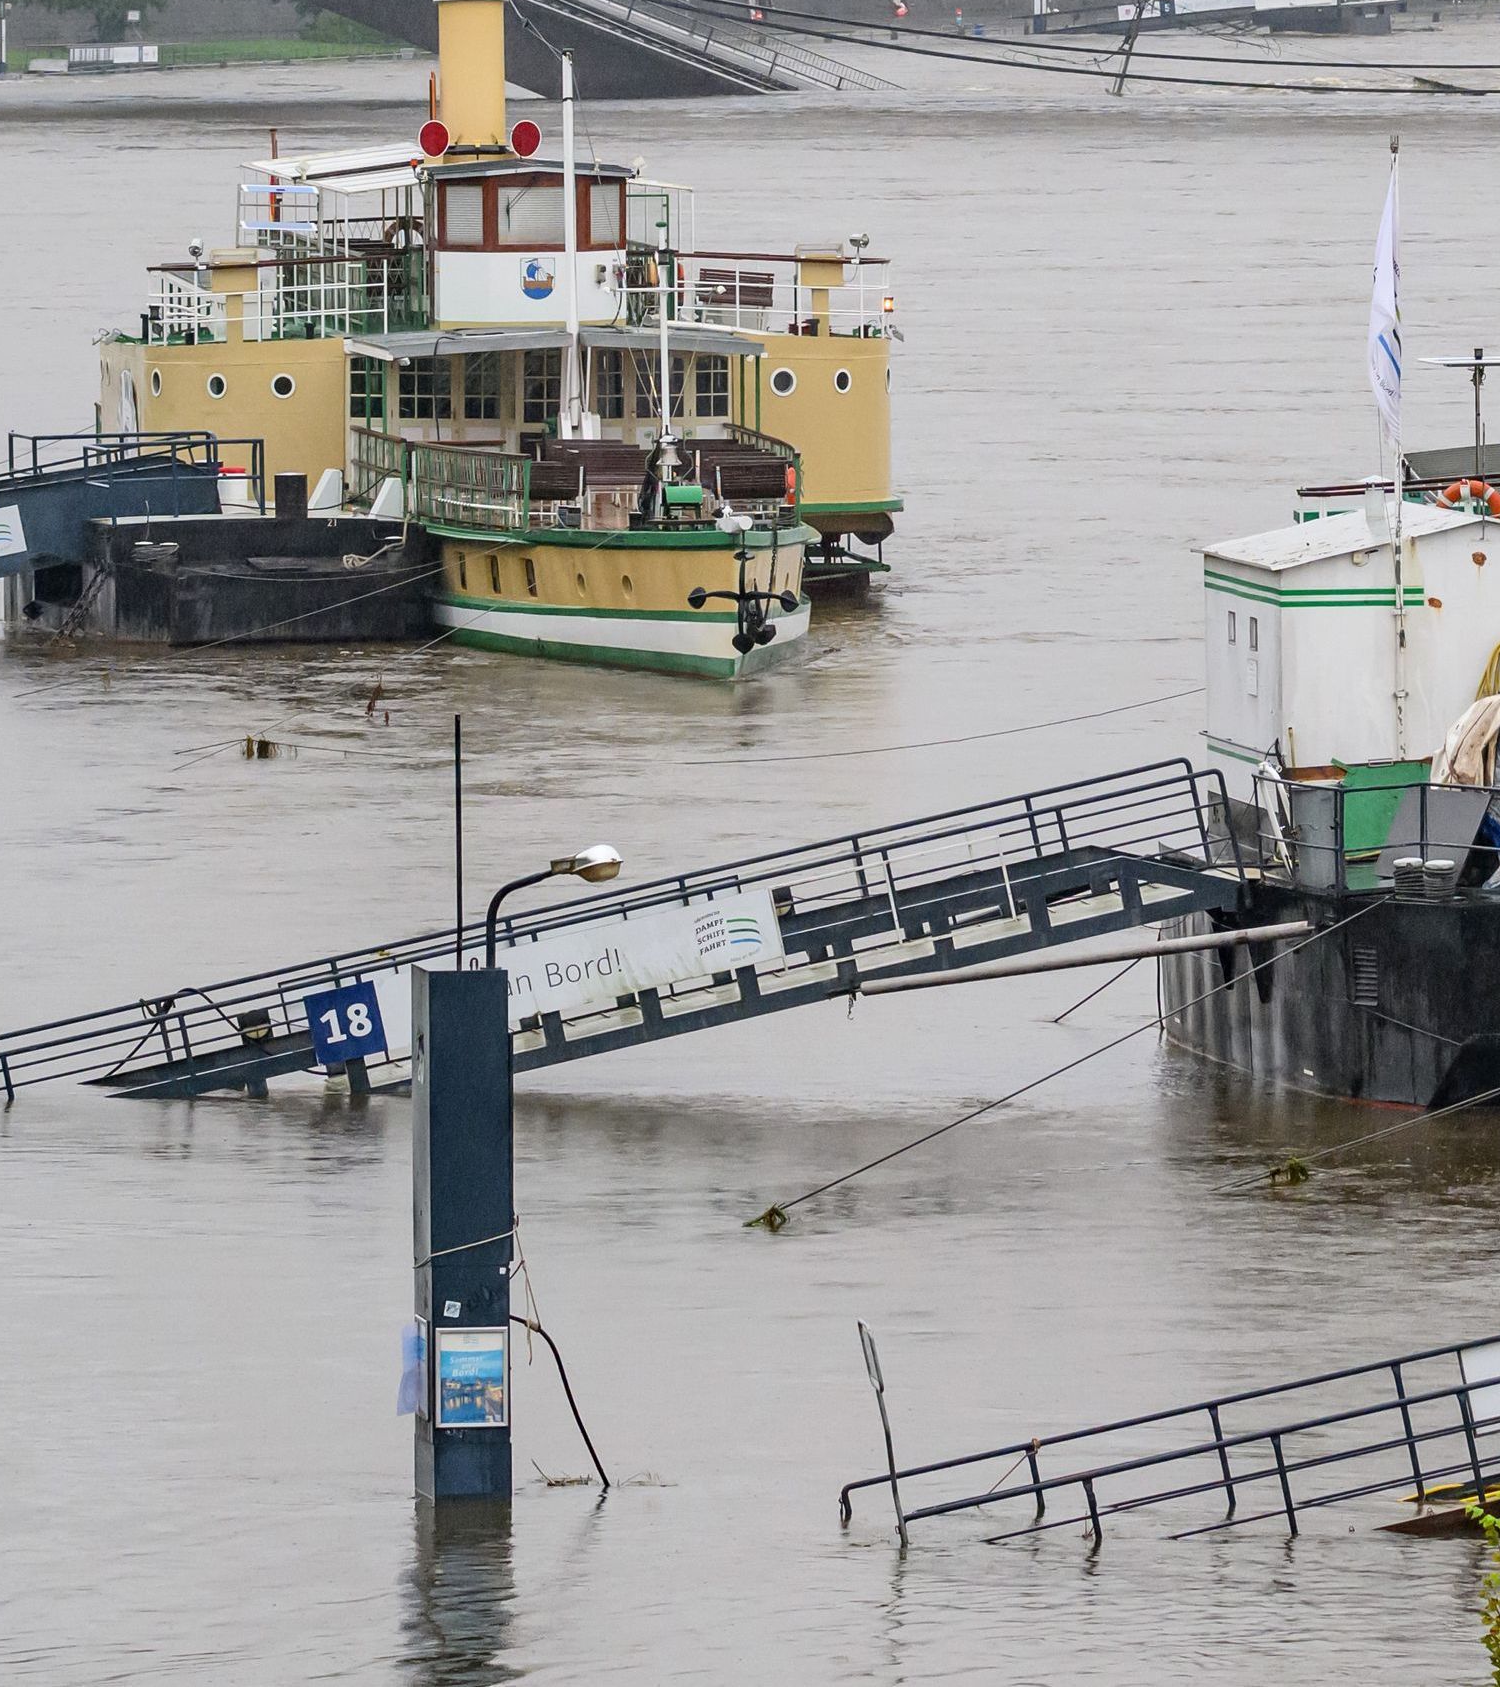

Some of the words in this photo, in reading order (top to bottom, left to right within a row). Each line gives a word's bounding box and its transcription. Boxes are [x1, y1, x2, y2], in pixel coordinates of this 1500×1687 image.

[695, 918, 724, 934] DAMPF
[697, 929, 725, 945] SCHIFF
[700, 940, 726, 955] FAHRT
[545, 948, 623, 988] Bord!
[319, 1002, 372, 1045] 18
